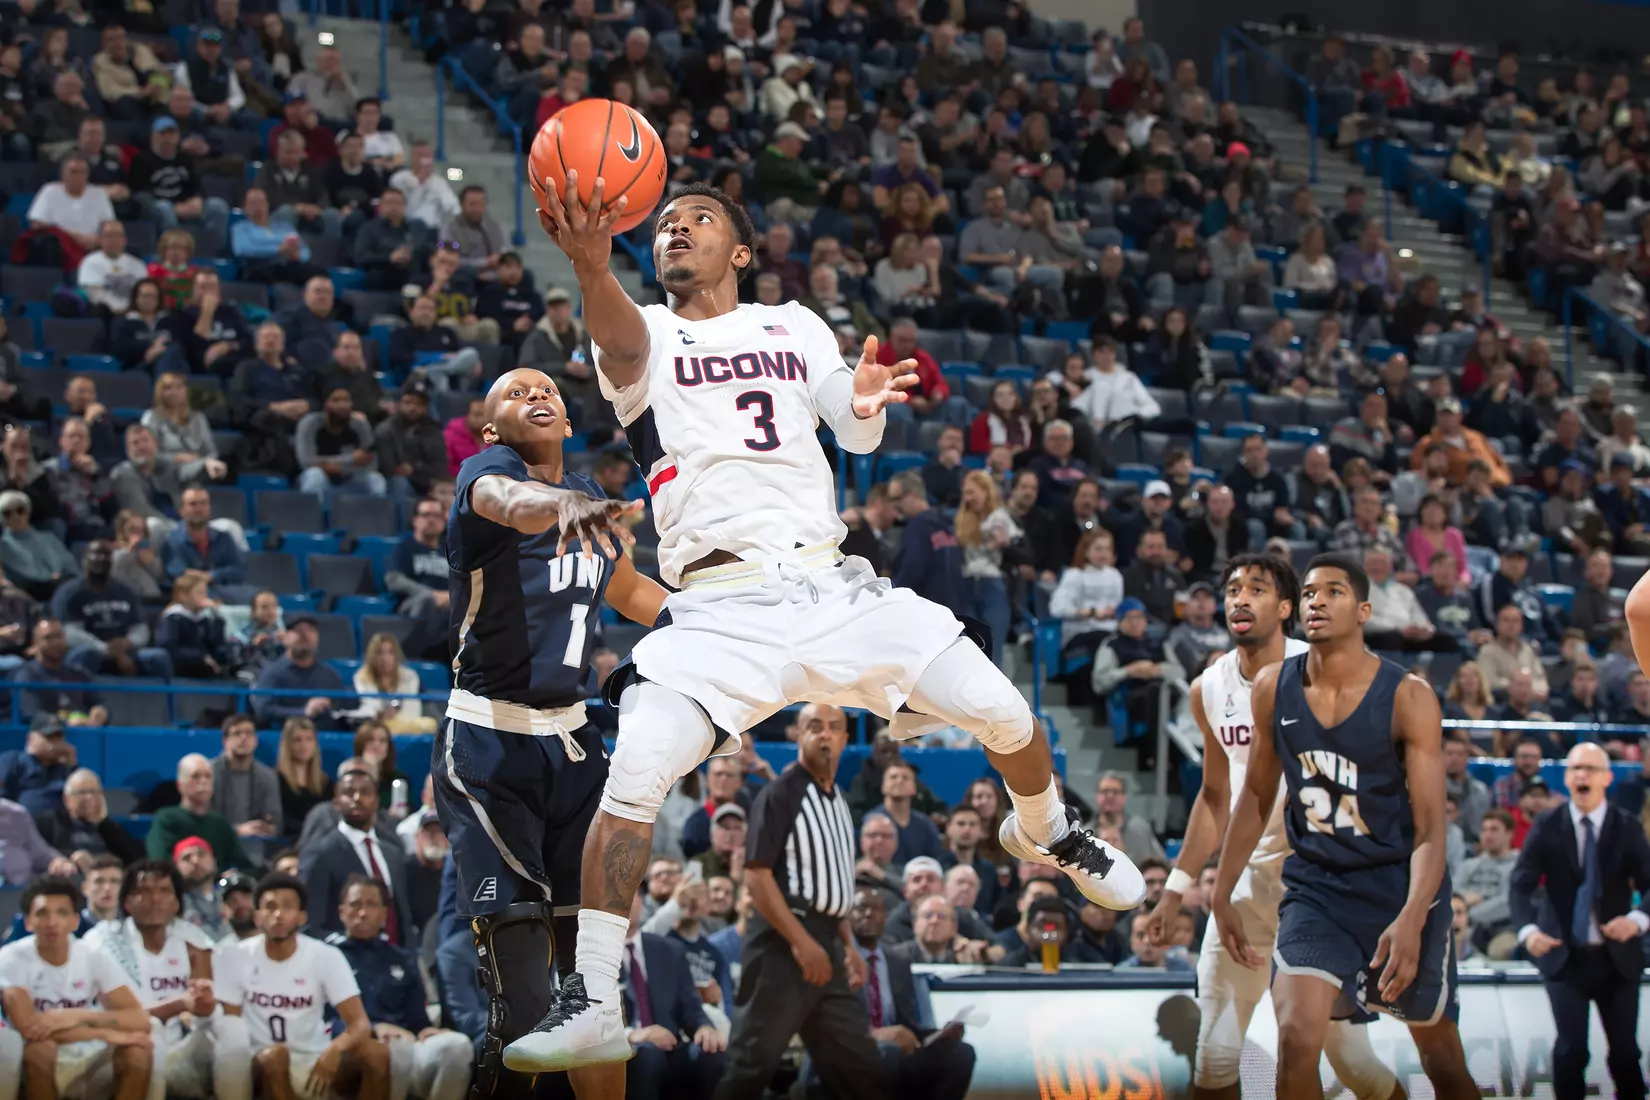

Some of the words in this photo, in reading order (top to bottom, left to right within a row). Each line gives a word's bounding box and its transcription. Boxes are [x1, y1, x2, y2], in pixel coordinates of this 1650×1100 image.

[674, 350, 807, 387] UCONN
[735, 390, 782, 452] 3
[547, 551, 605, 600] UN
[562, 603, 590, 669] 1
[1220, 725, 1254, 746] UC
[1298, 750, 1358, 791] UNH
[1299, 786, 1372, 837] 24
[243, 990, 313, 1009] UCONN
[268, 1014, 287, 1042] 0
